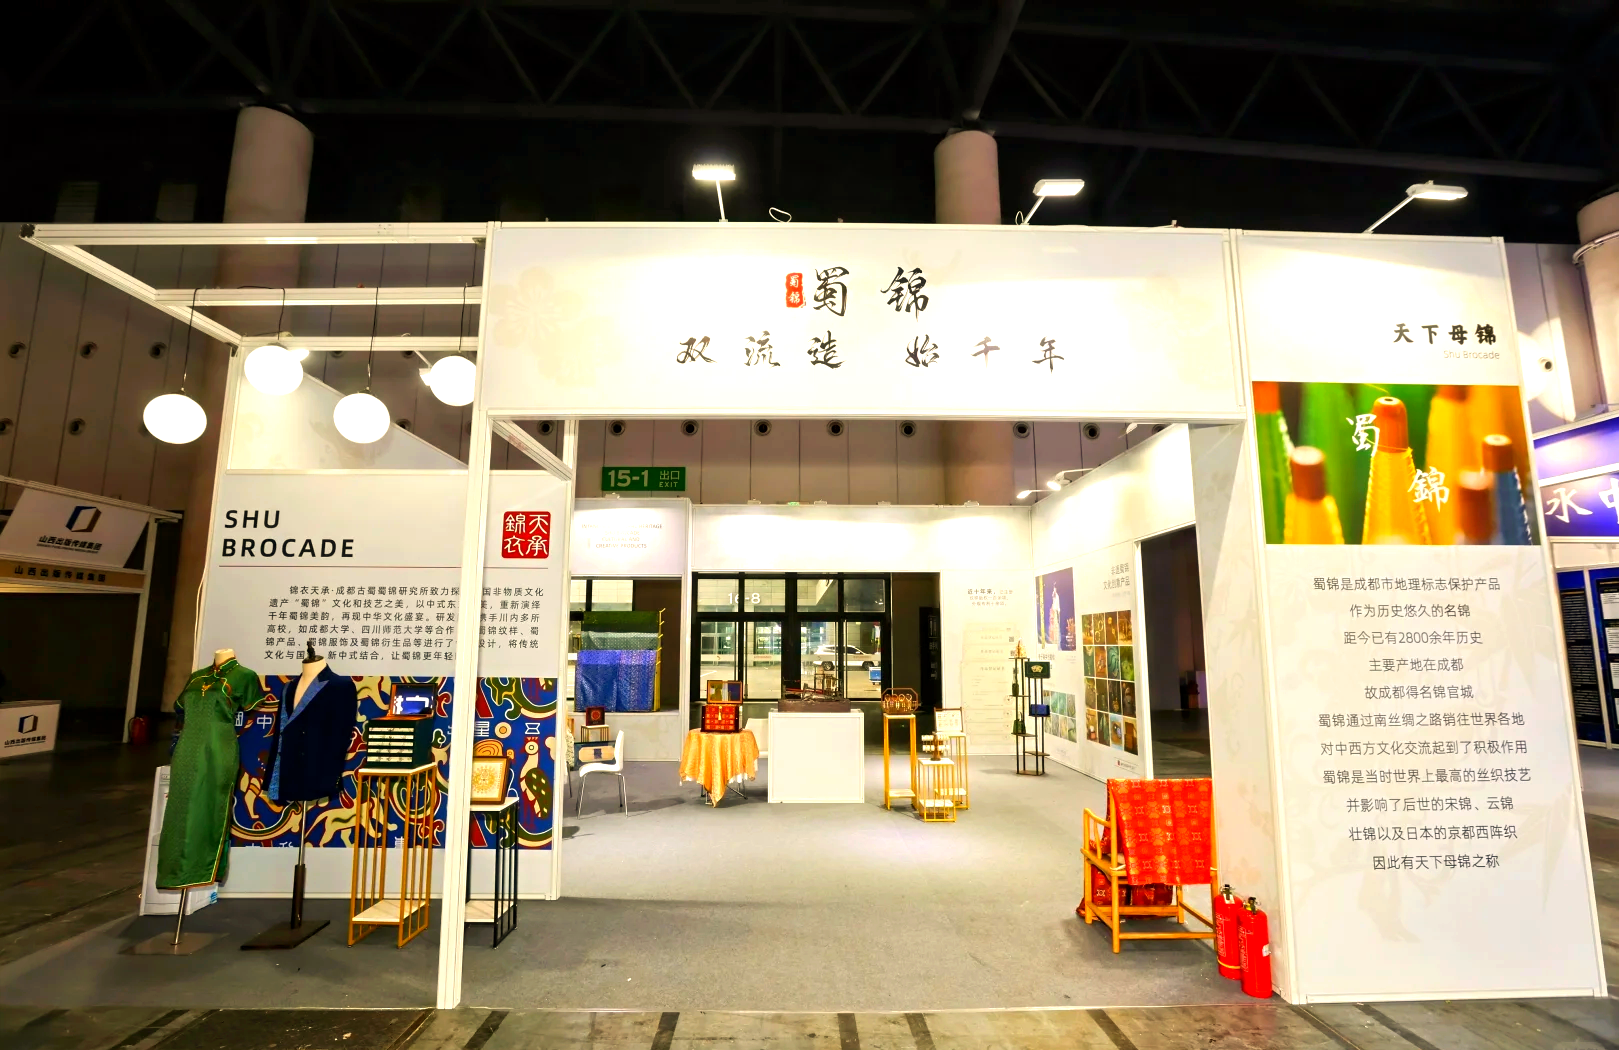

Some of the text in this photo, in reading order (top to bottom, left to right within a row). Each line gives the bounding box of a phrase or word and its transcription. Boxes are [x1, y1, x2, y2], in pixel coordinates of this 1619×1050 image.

[813, 266, 929, 322] 蜀锦
[1393, 323, 1497, 345] 天下母锦
[1443, 350, 1501, 360] Shu Brocade
[608, 469, 680, 488] 15-1 出口
[224, 510, 281, 529] SHU
[38, 535, 103, 551] 山西出版传媒集团
[222, 538, 355, 557] BROCADE
[14, 565, 106, 582] 山西出版传媒集团
[1313, 577, 1501, 591] 蜀锦是成都市地理标志保护产品
[1349, 604, 1471, 618] 作为历史悠久的名锦
[1343, 630, 1484, 645] 距今已有2800余年历史
[1369, 658, 1464, 672] 主要产地在成都
[1364, 685, 1474, 699] 故成都得名锦官城
[1318, 712, 1526, 728] 蜀锦通过南丝绸之路销往世界各地
[1320, 740, 1528, 756] 对中西方文化交流起到了积极作用
[1323, 768, 1532, 784] 蜀锦是当时世界上最高的丝织技艺
[1346, 796, 1514, 812] 并影响了后世的宋锦、云锦
[1348, 825, 1518, 841] 壮锦以及日本的京都西阵织
[1373, 853, 1500, 870] 因此有天下母锦之称
